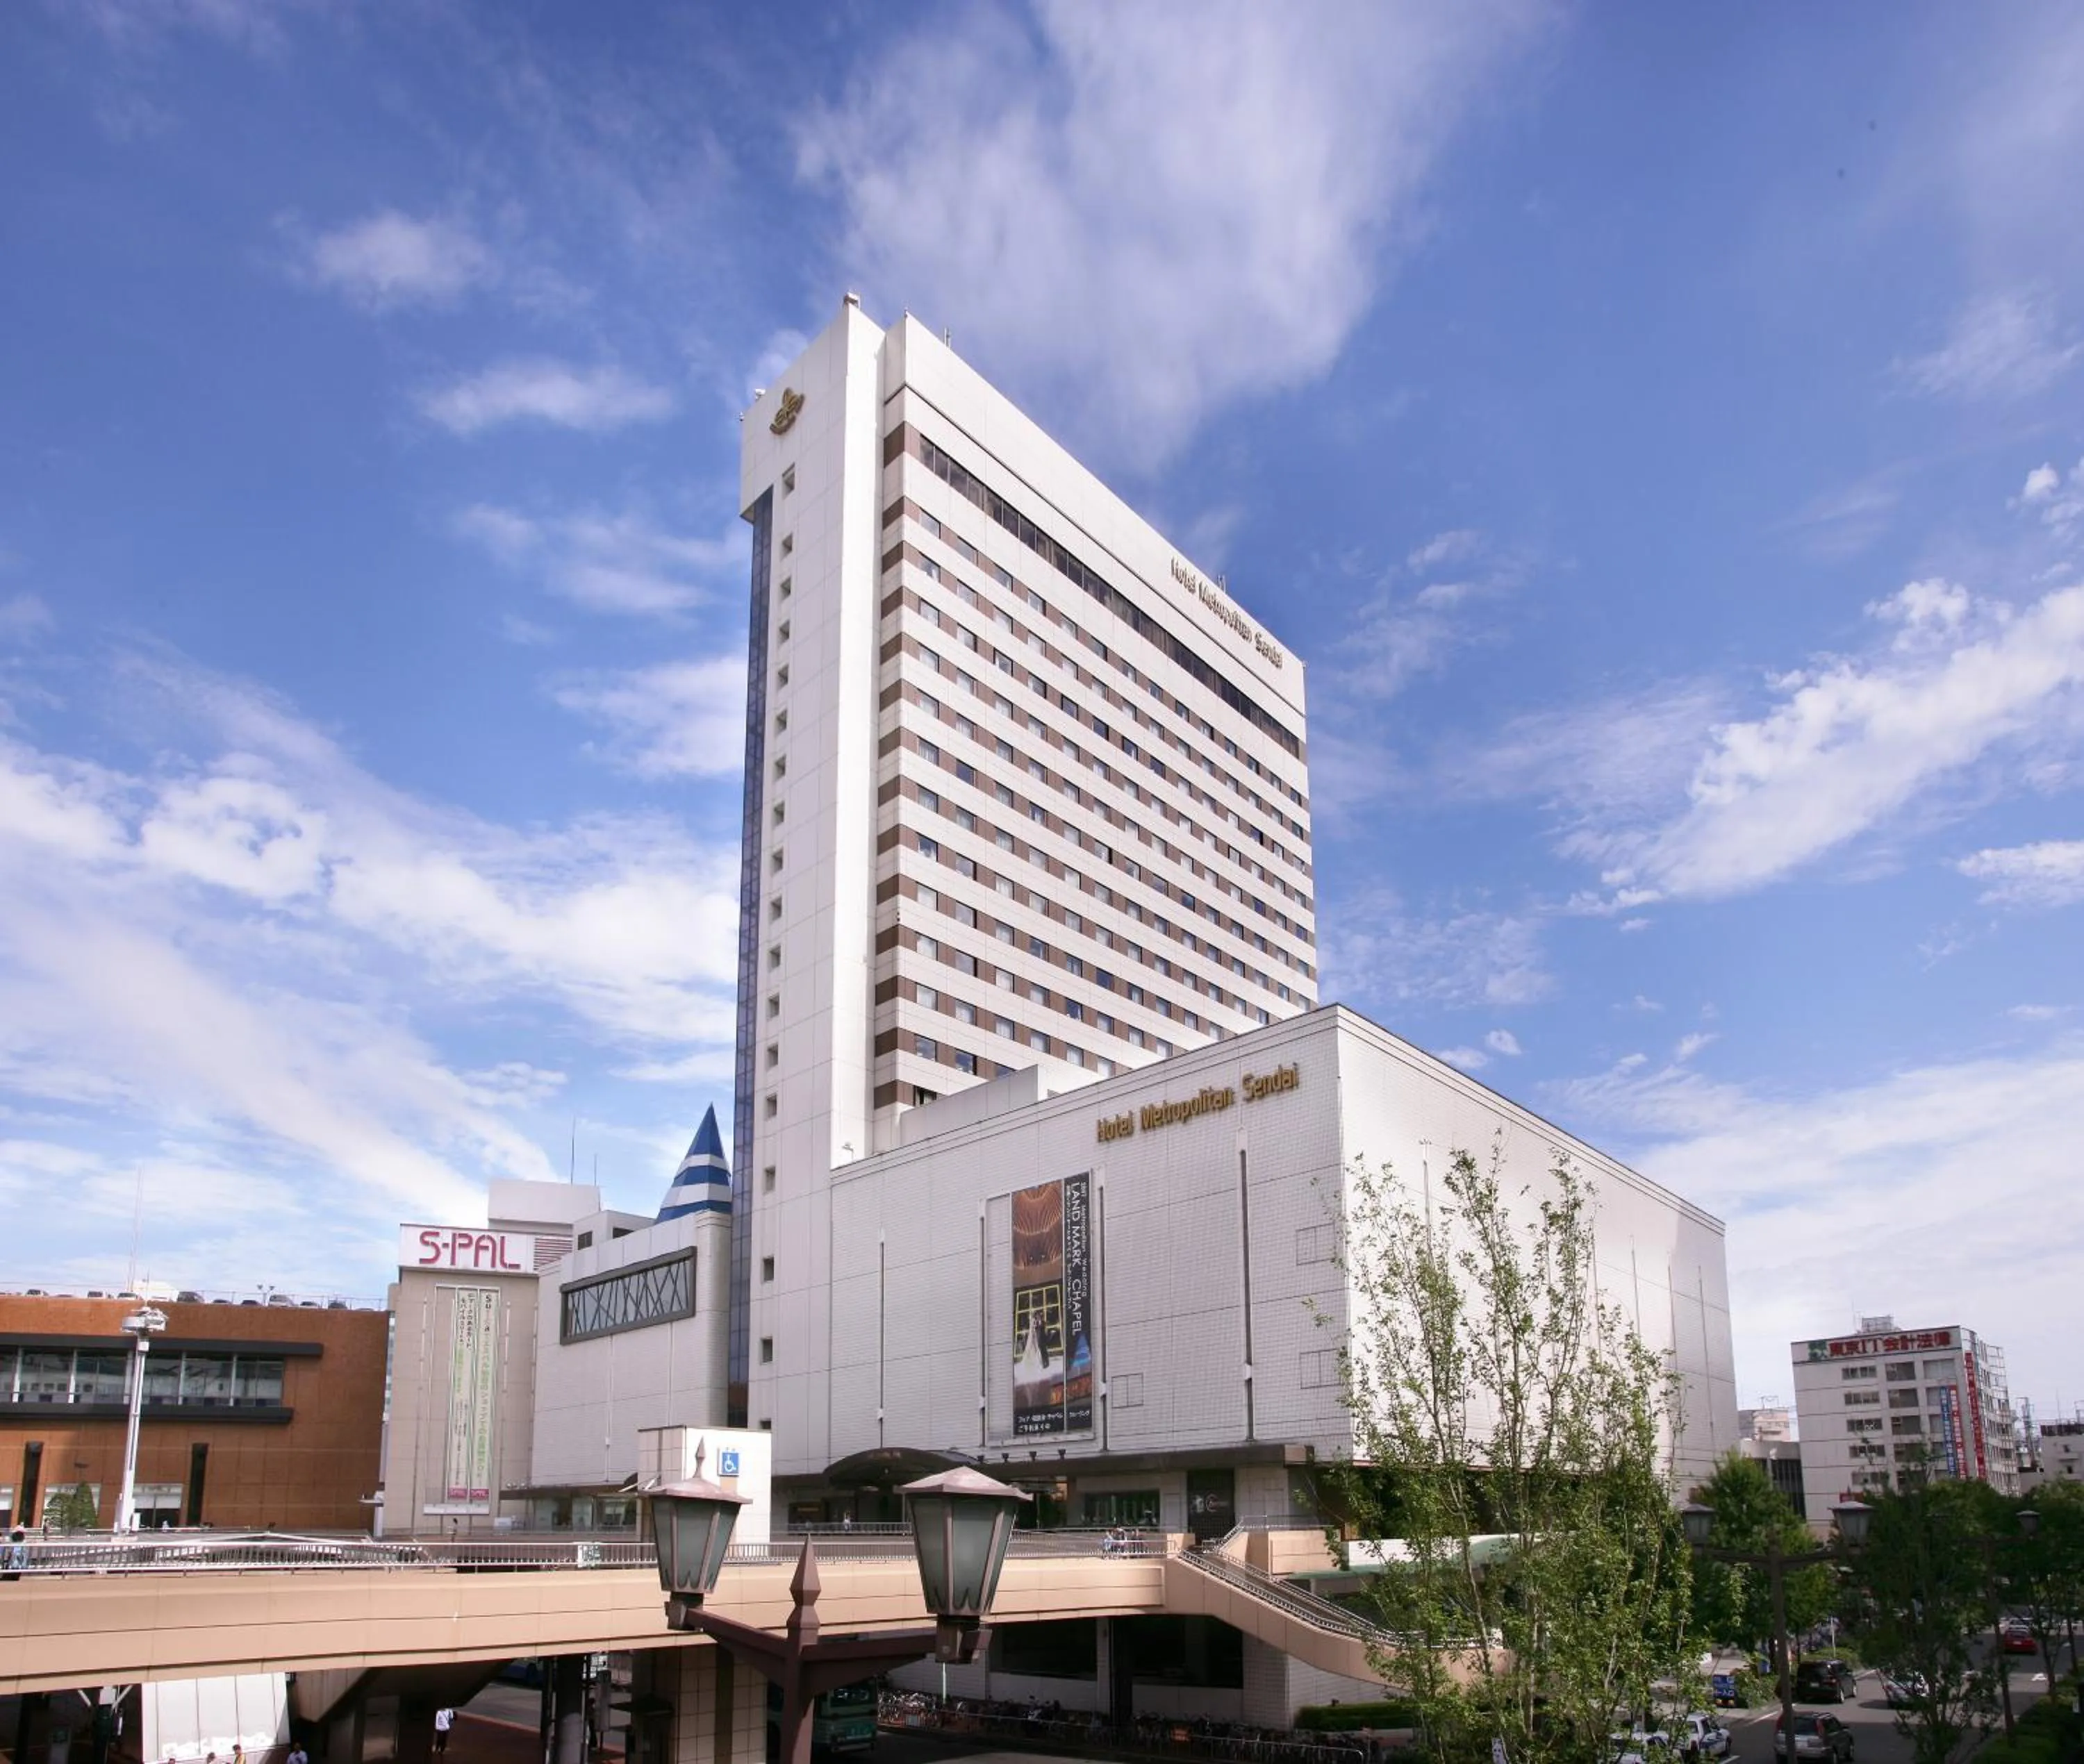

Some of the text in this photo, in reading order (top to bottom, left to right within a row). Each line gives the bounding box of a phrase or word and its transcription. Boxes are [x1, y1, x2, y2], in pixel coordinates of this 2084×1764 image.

[1097, 1061, 1300, 1142] Hotel Metropolitan Sendai
[419, 1231, 522, 1270] S-PAL
[1071, 1182, 1082, 1336] LAND MARK CHAPEL
